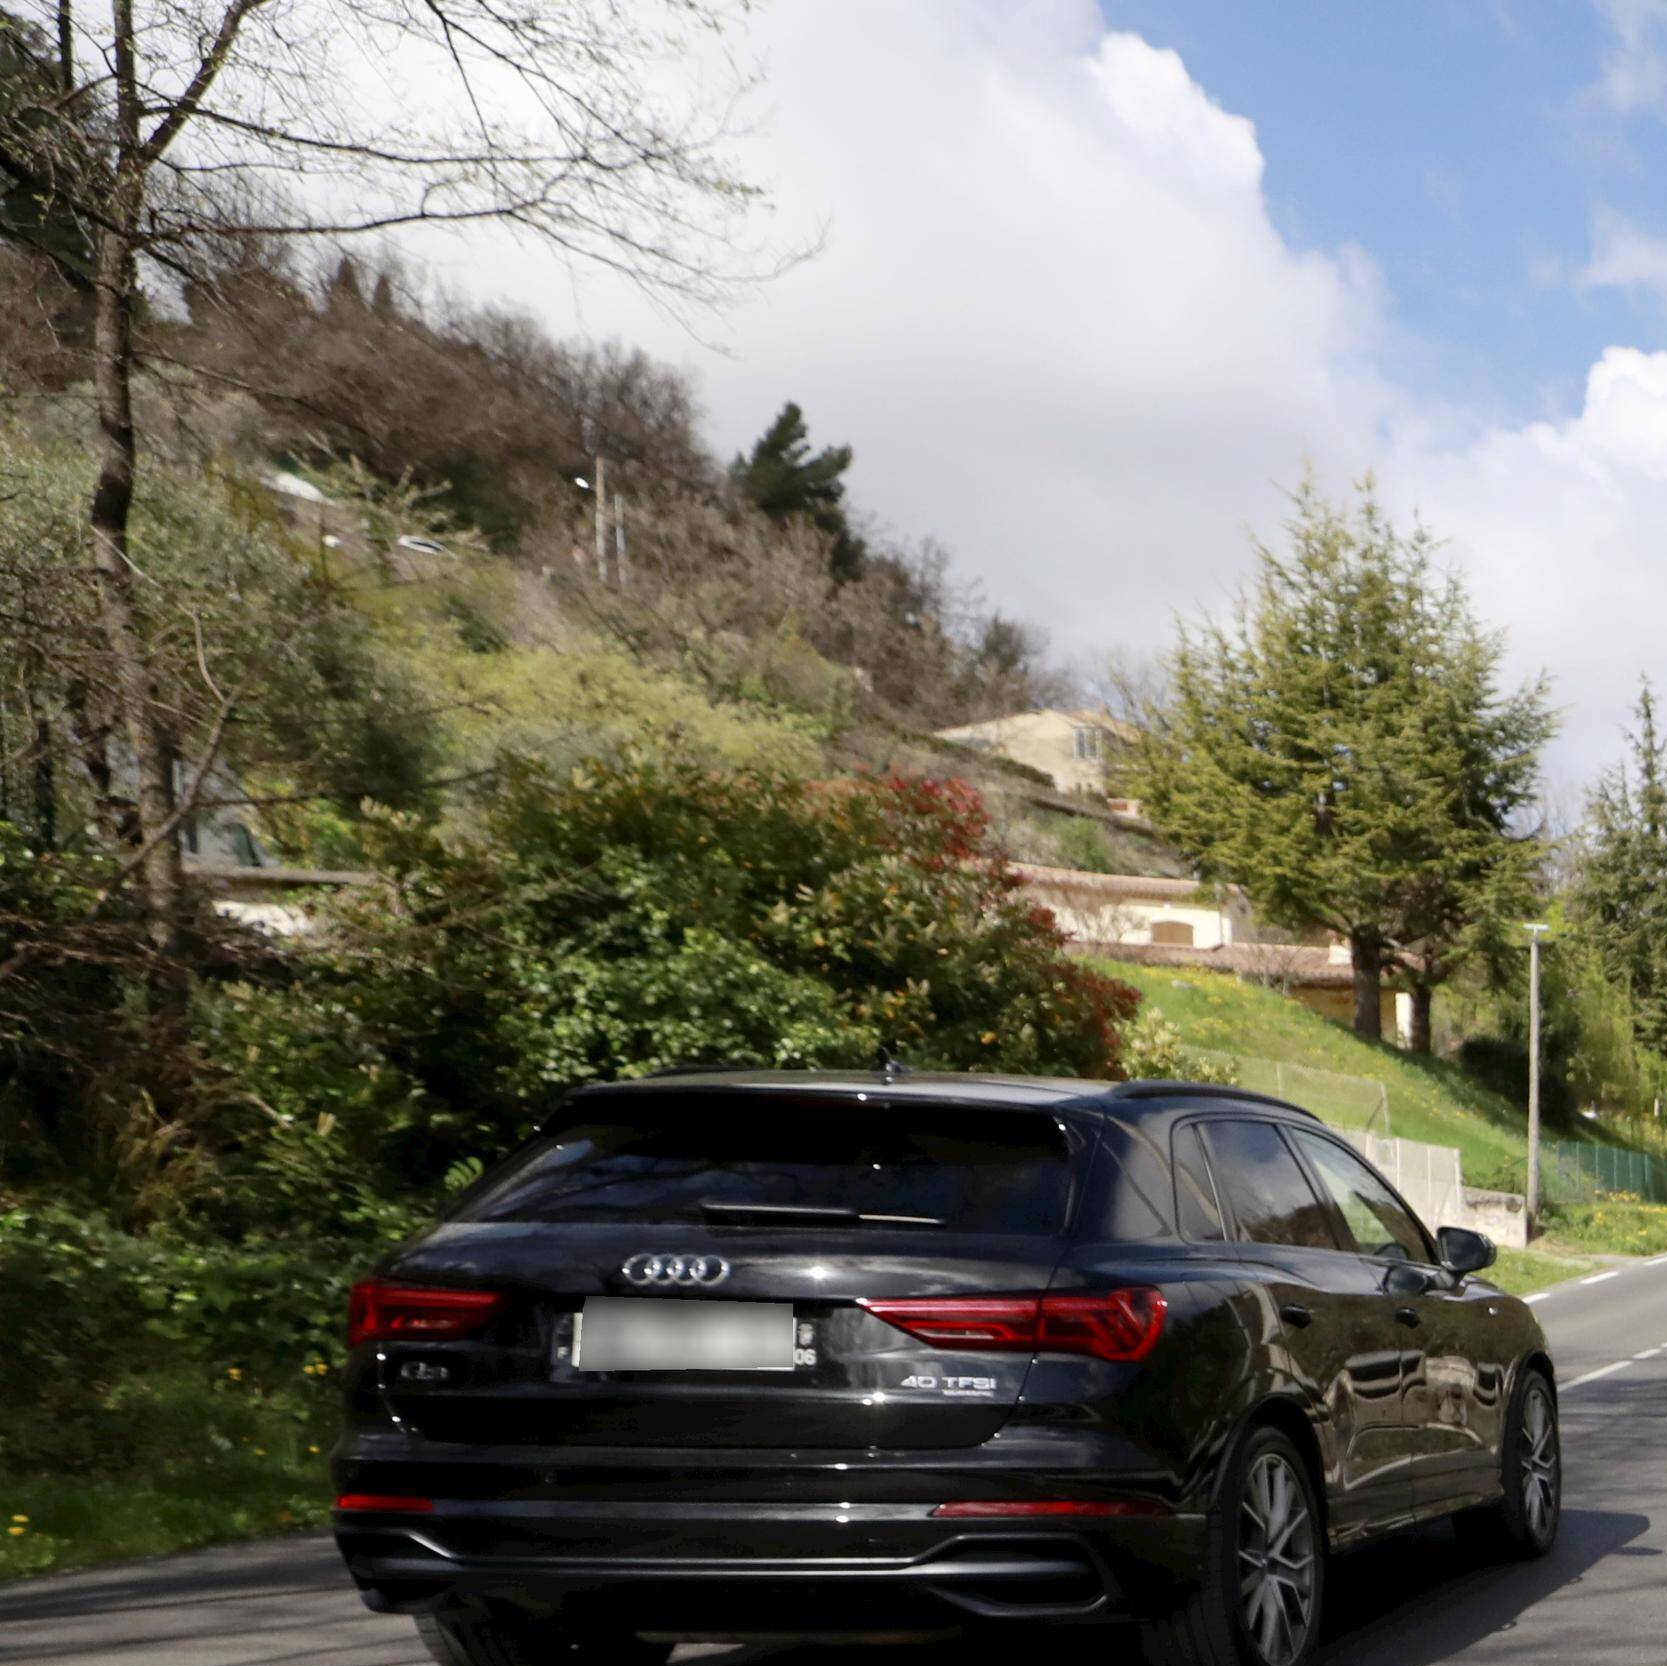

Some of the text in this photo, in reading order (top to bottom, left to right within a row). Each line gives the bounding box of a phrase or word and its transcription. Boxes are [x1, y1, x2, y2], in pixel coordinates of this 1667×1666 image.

[795, 1349, 817, 1366] 06
[900, 1376, 997, 1390] 40 TFSI
